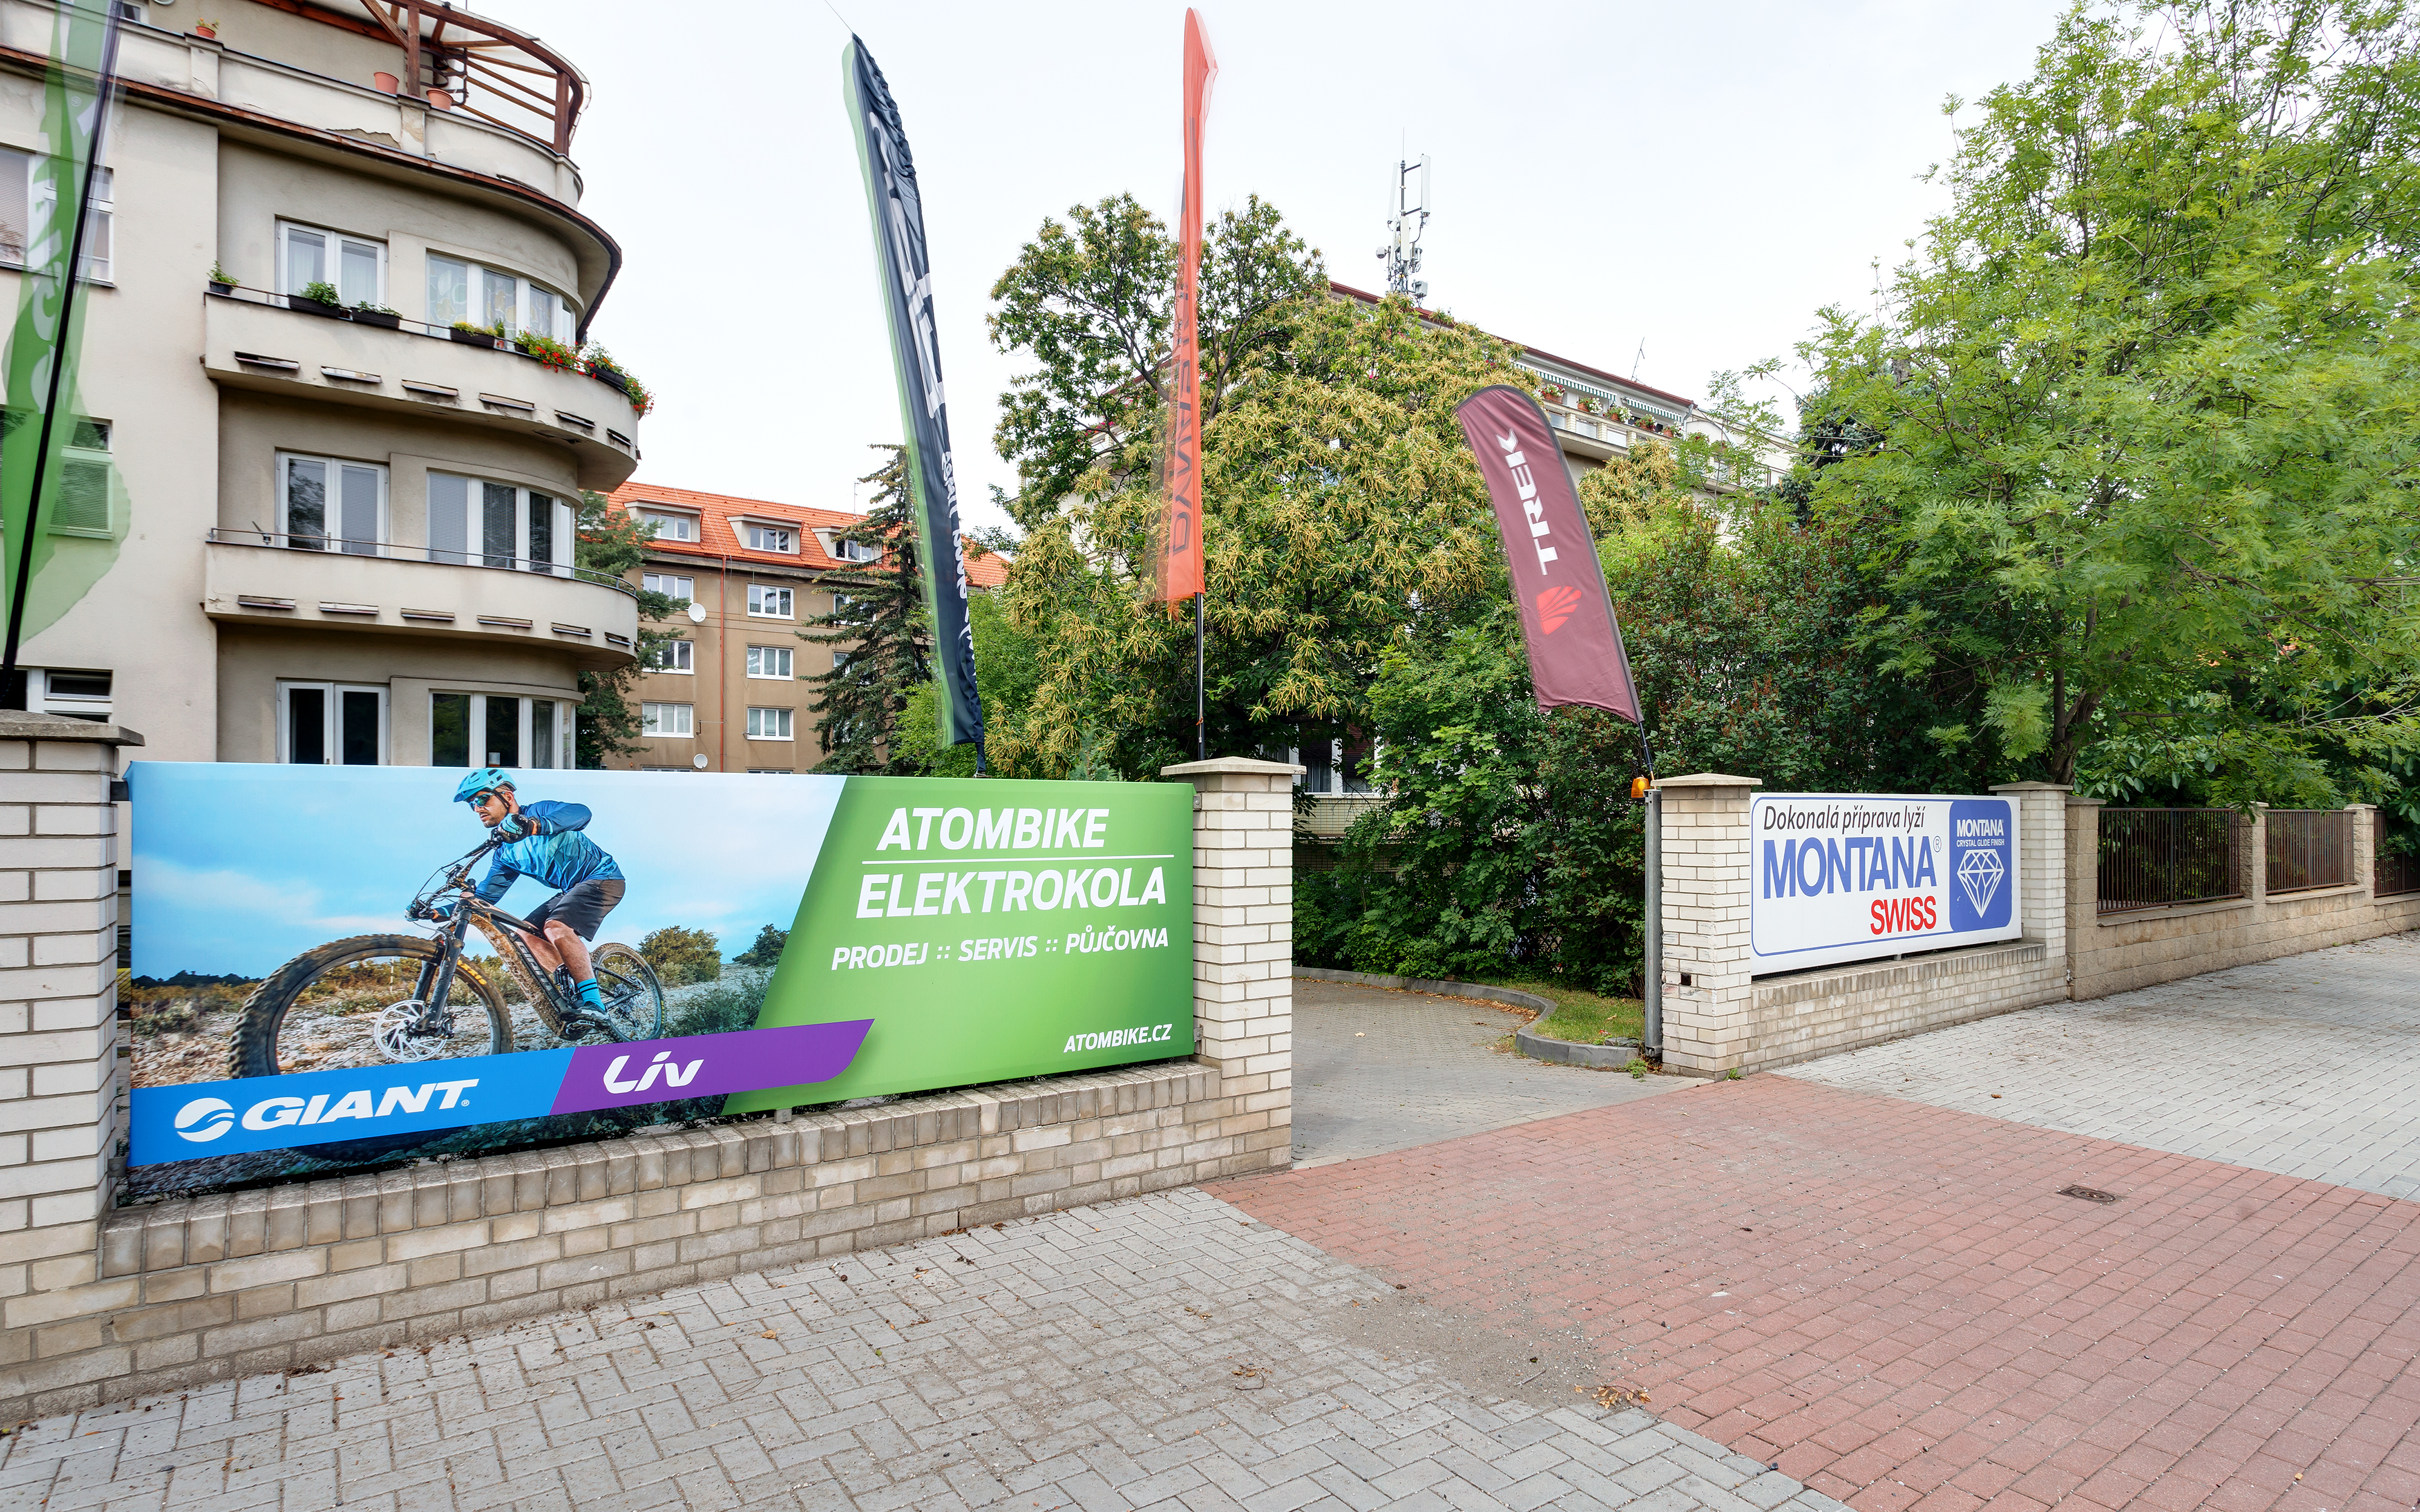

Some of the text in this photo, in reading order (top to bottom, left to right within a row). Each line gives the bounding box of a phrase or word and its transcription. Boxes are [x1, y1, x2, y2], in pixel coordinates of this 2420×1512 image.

[1496, 427, 1559, 576] TREK
[875, 807, 1110, 851] ATOMBIKE
[1764, 805, 1926, 835] Dokonalá příprava lyží
[1957, 839, 1977, 847] CRYSTAL
[1977, 838, 1990, 847] GLIDE
[855, 866, 1166, 919] ELEKTROKOLA
[1870, 895, 1937, 935] SWISS
[831, 942, 928, 971] PRODEJ
[958, 935, 1038, 962] SERVIS
[1065, 924, 1168, 954] PŮJČOVNA
[1063, 1023, 1172, 1053] ATOMBIKE.CZ
[603, 1051, 704, 1094] Liv
